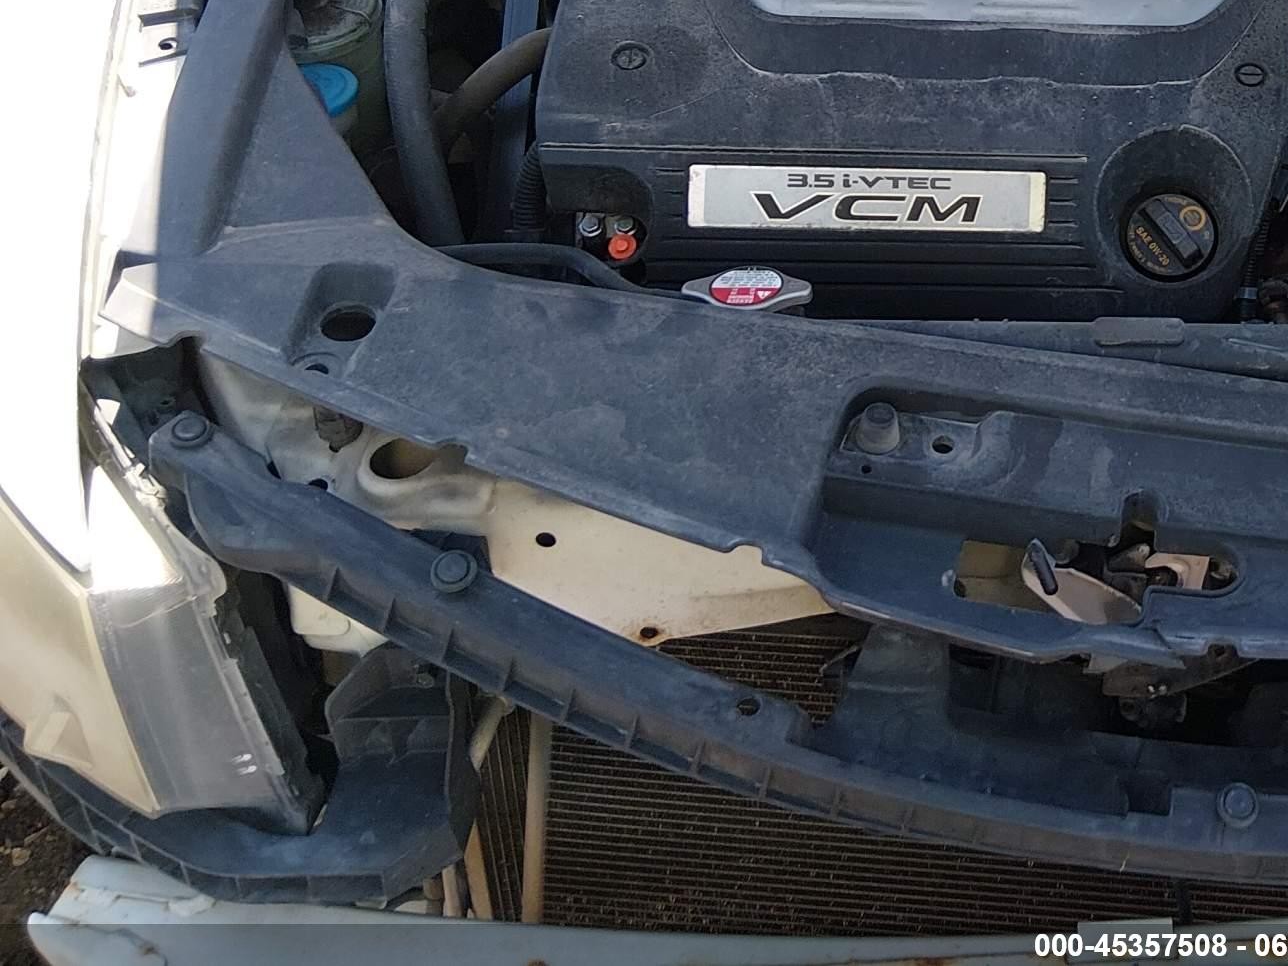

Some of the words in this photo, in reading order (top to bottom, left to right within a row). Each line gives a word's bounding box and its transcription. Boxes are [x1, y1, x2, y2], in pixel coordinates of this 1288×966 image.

[787, 173, 835, 188] 3.5
[843, 174, 952, 190] i-VTEC
[751, 192, 983, 225] VCM
[1135, 226, 1153, 244] SAE
[1149, 242, 1170, 267] 0W-20
